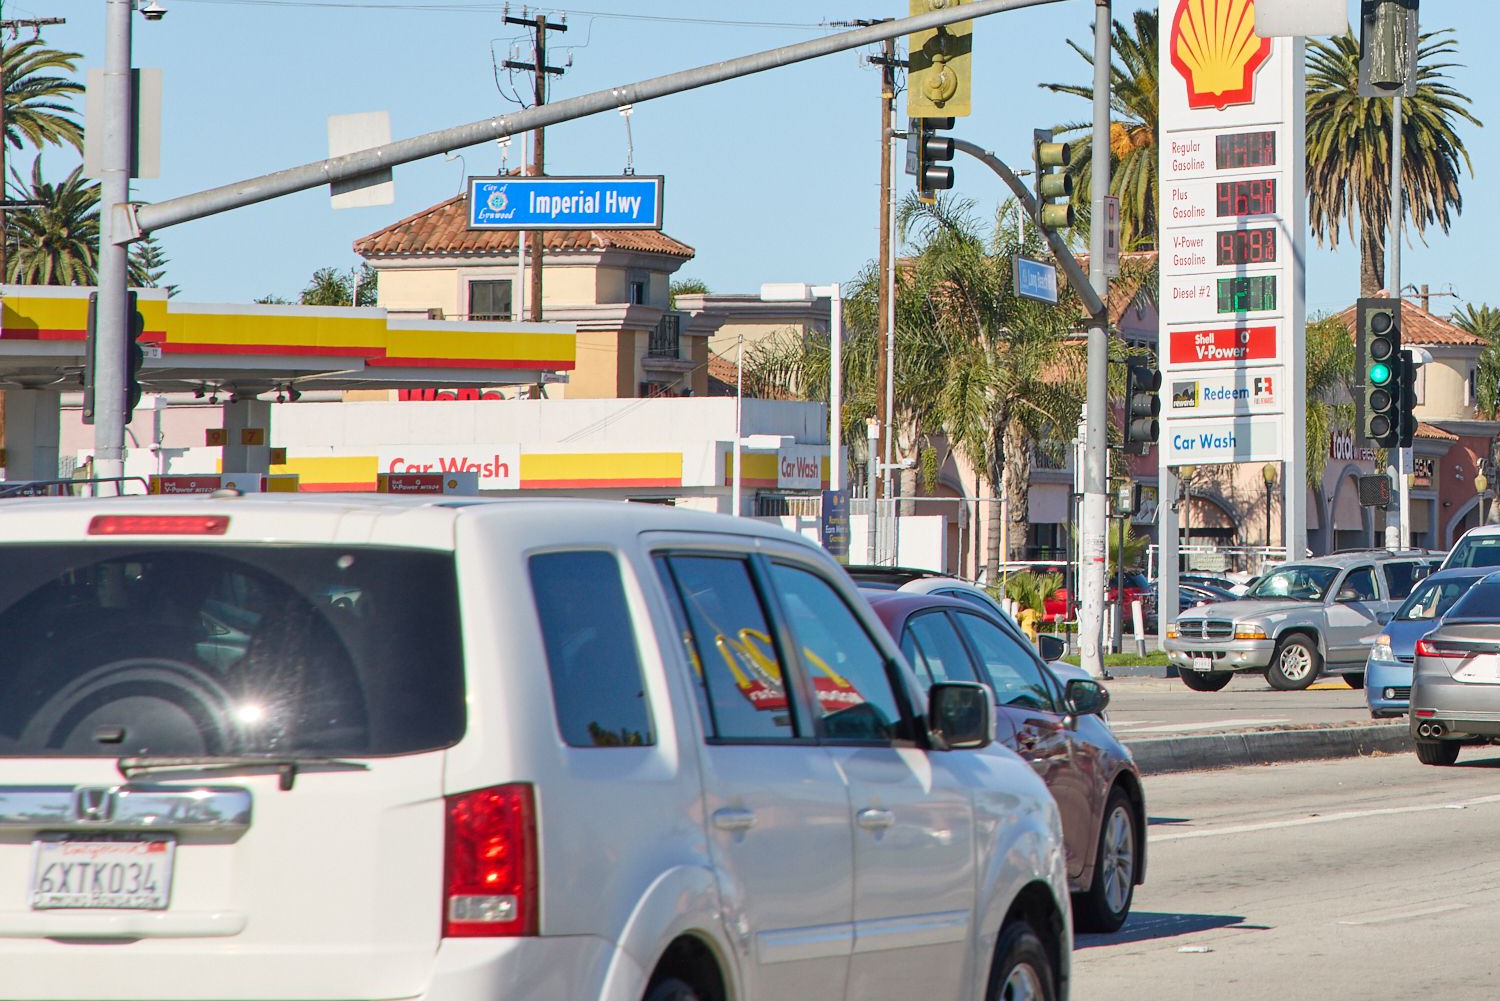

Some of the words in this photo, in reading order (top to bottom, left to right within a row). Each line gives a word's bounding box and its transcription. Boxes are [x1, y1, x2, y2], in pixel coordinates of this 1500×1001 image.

[1172, 140, 1200, 156] Regular
[1172, 157, 1205, 171] Gasoline
[1172, 188, 1188, 200] Plus
[530, 190, 600, 219] Imperial
[605, 190, 642, 219] Hwy
[1172, 205, 1205, 218] Gasoline
[1174, 236, 1204, 248] V-Power
[1174, 252, 1206, 265] Gasoline
[1174, 285, 1196, 299] Diesel
[1199, 285, 1211, 297] #2
[1195, 333, 1214, 345] Shell
[1196, 346, 1245, 359] V-Power
[1204, 386, 1250, 400] Redeem
[1174, 400, 1195, 408] rewards
[1174, 435, 1196, 450] Car
[1200, 432, 1237, 449] Wash
[390, 457, 433, 473] Car
[438, 455, 509, 478] Wash
[782, 456, 795, 478] Car
[796, 456, 818, 478] Wash
[39, 862, 158, 894] 6XTK034
